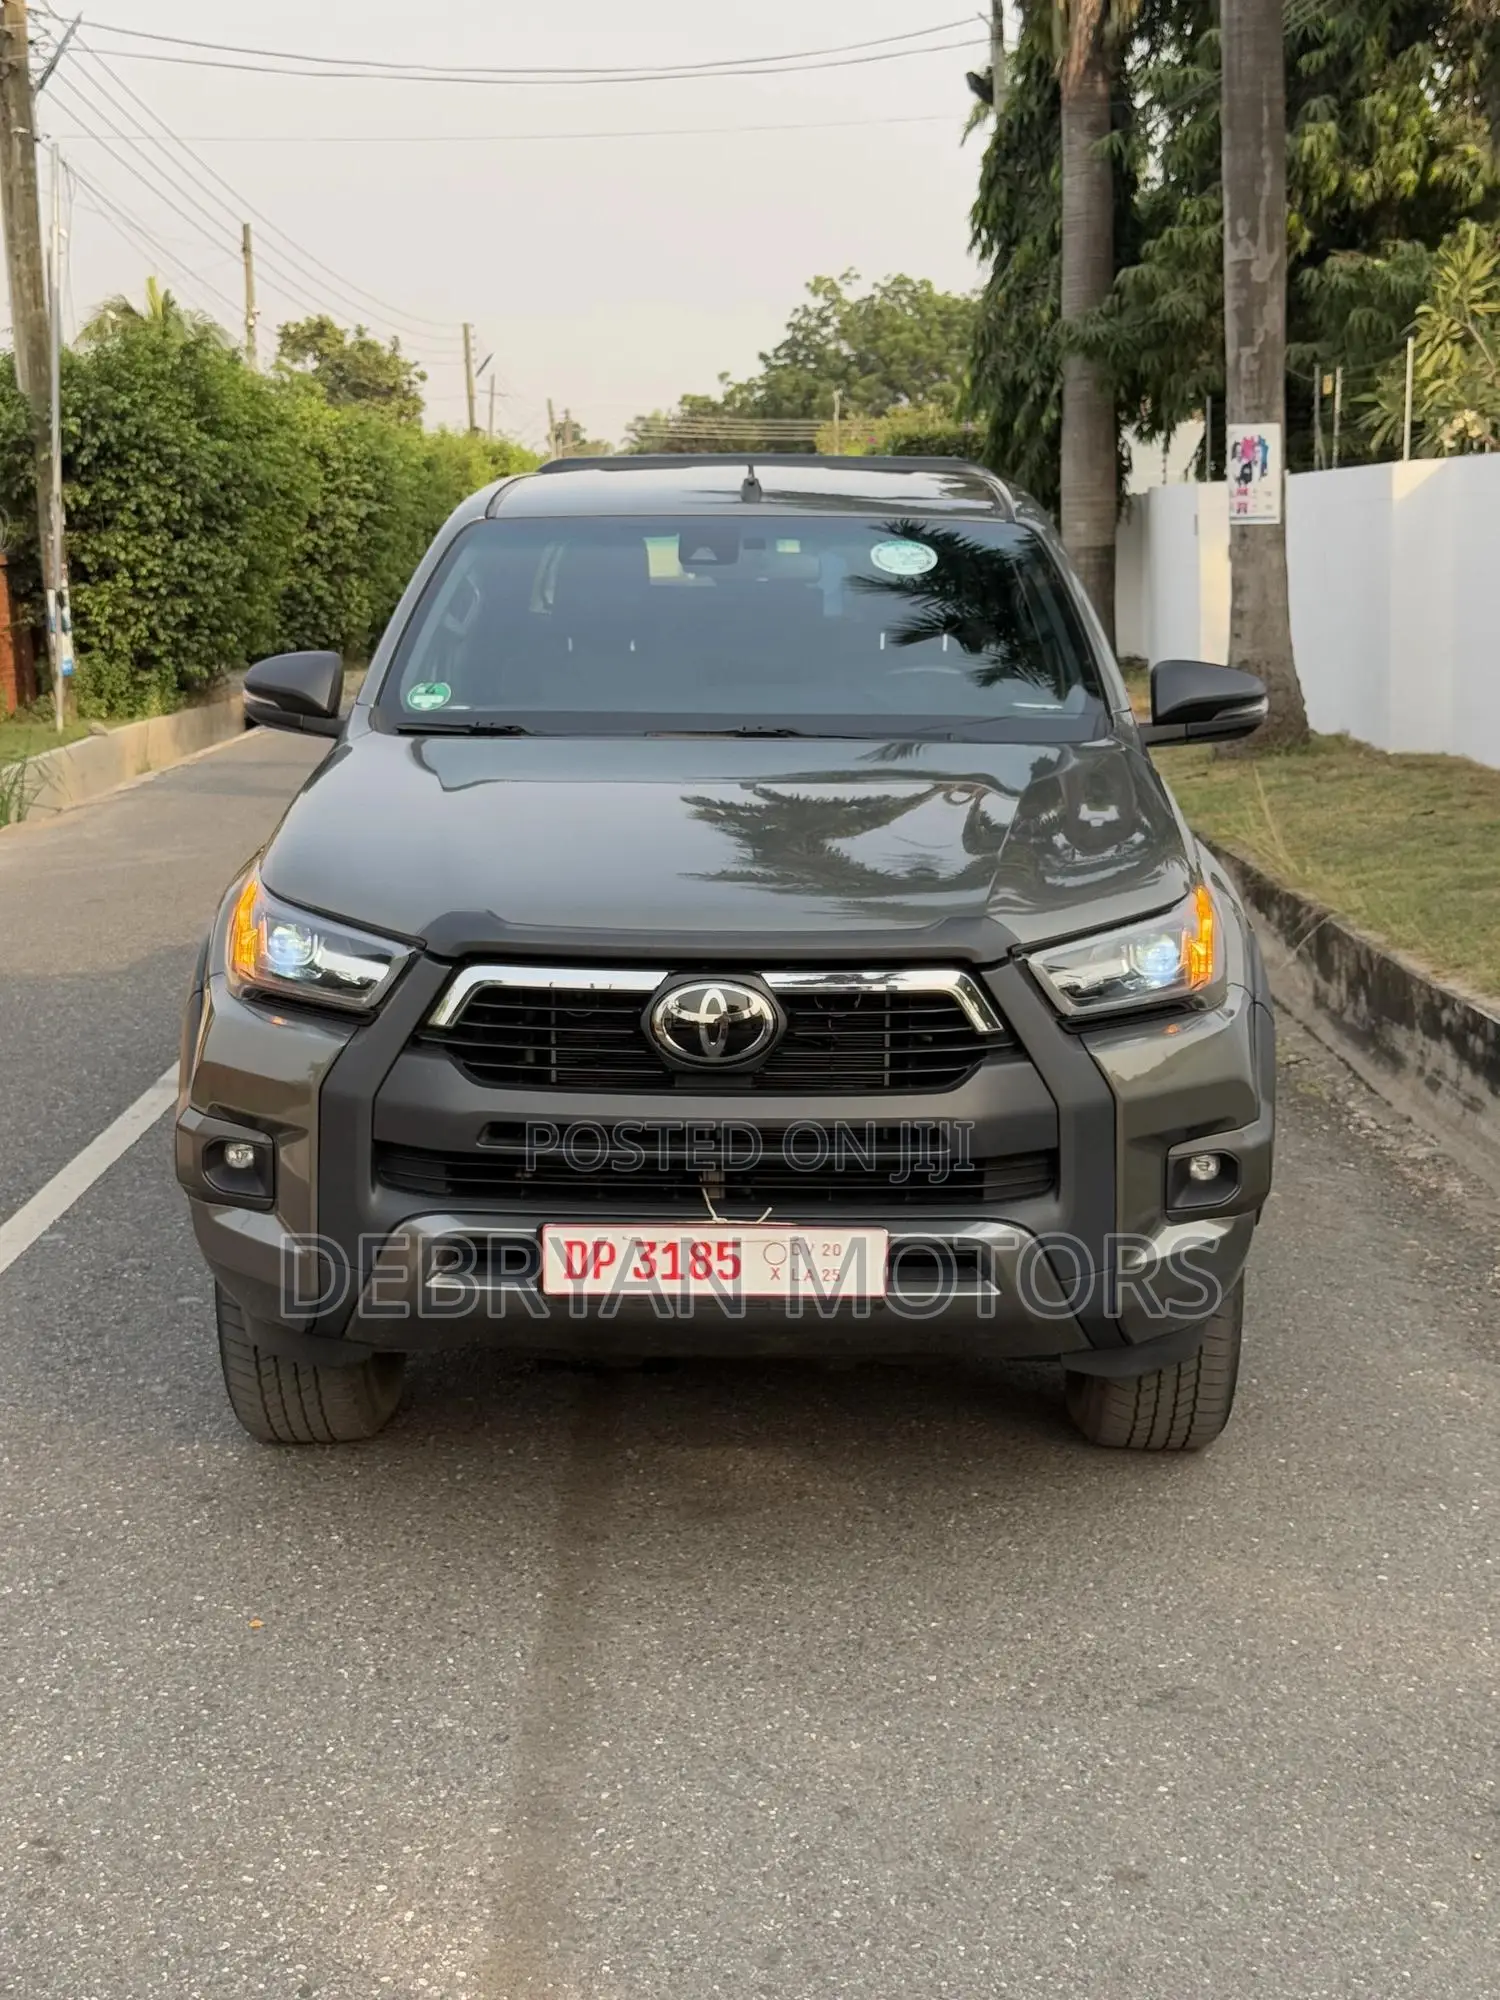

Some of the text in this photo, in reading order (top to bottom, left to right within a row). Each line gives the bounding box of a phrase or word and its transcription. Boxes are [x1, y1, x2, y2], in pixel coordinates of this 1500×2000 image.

[821, 1243, 842, 1257] 20
[564, 1240, 742, 1281] DP 3185
[770, 1266, 841, 1282] X LA 25
